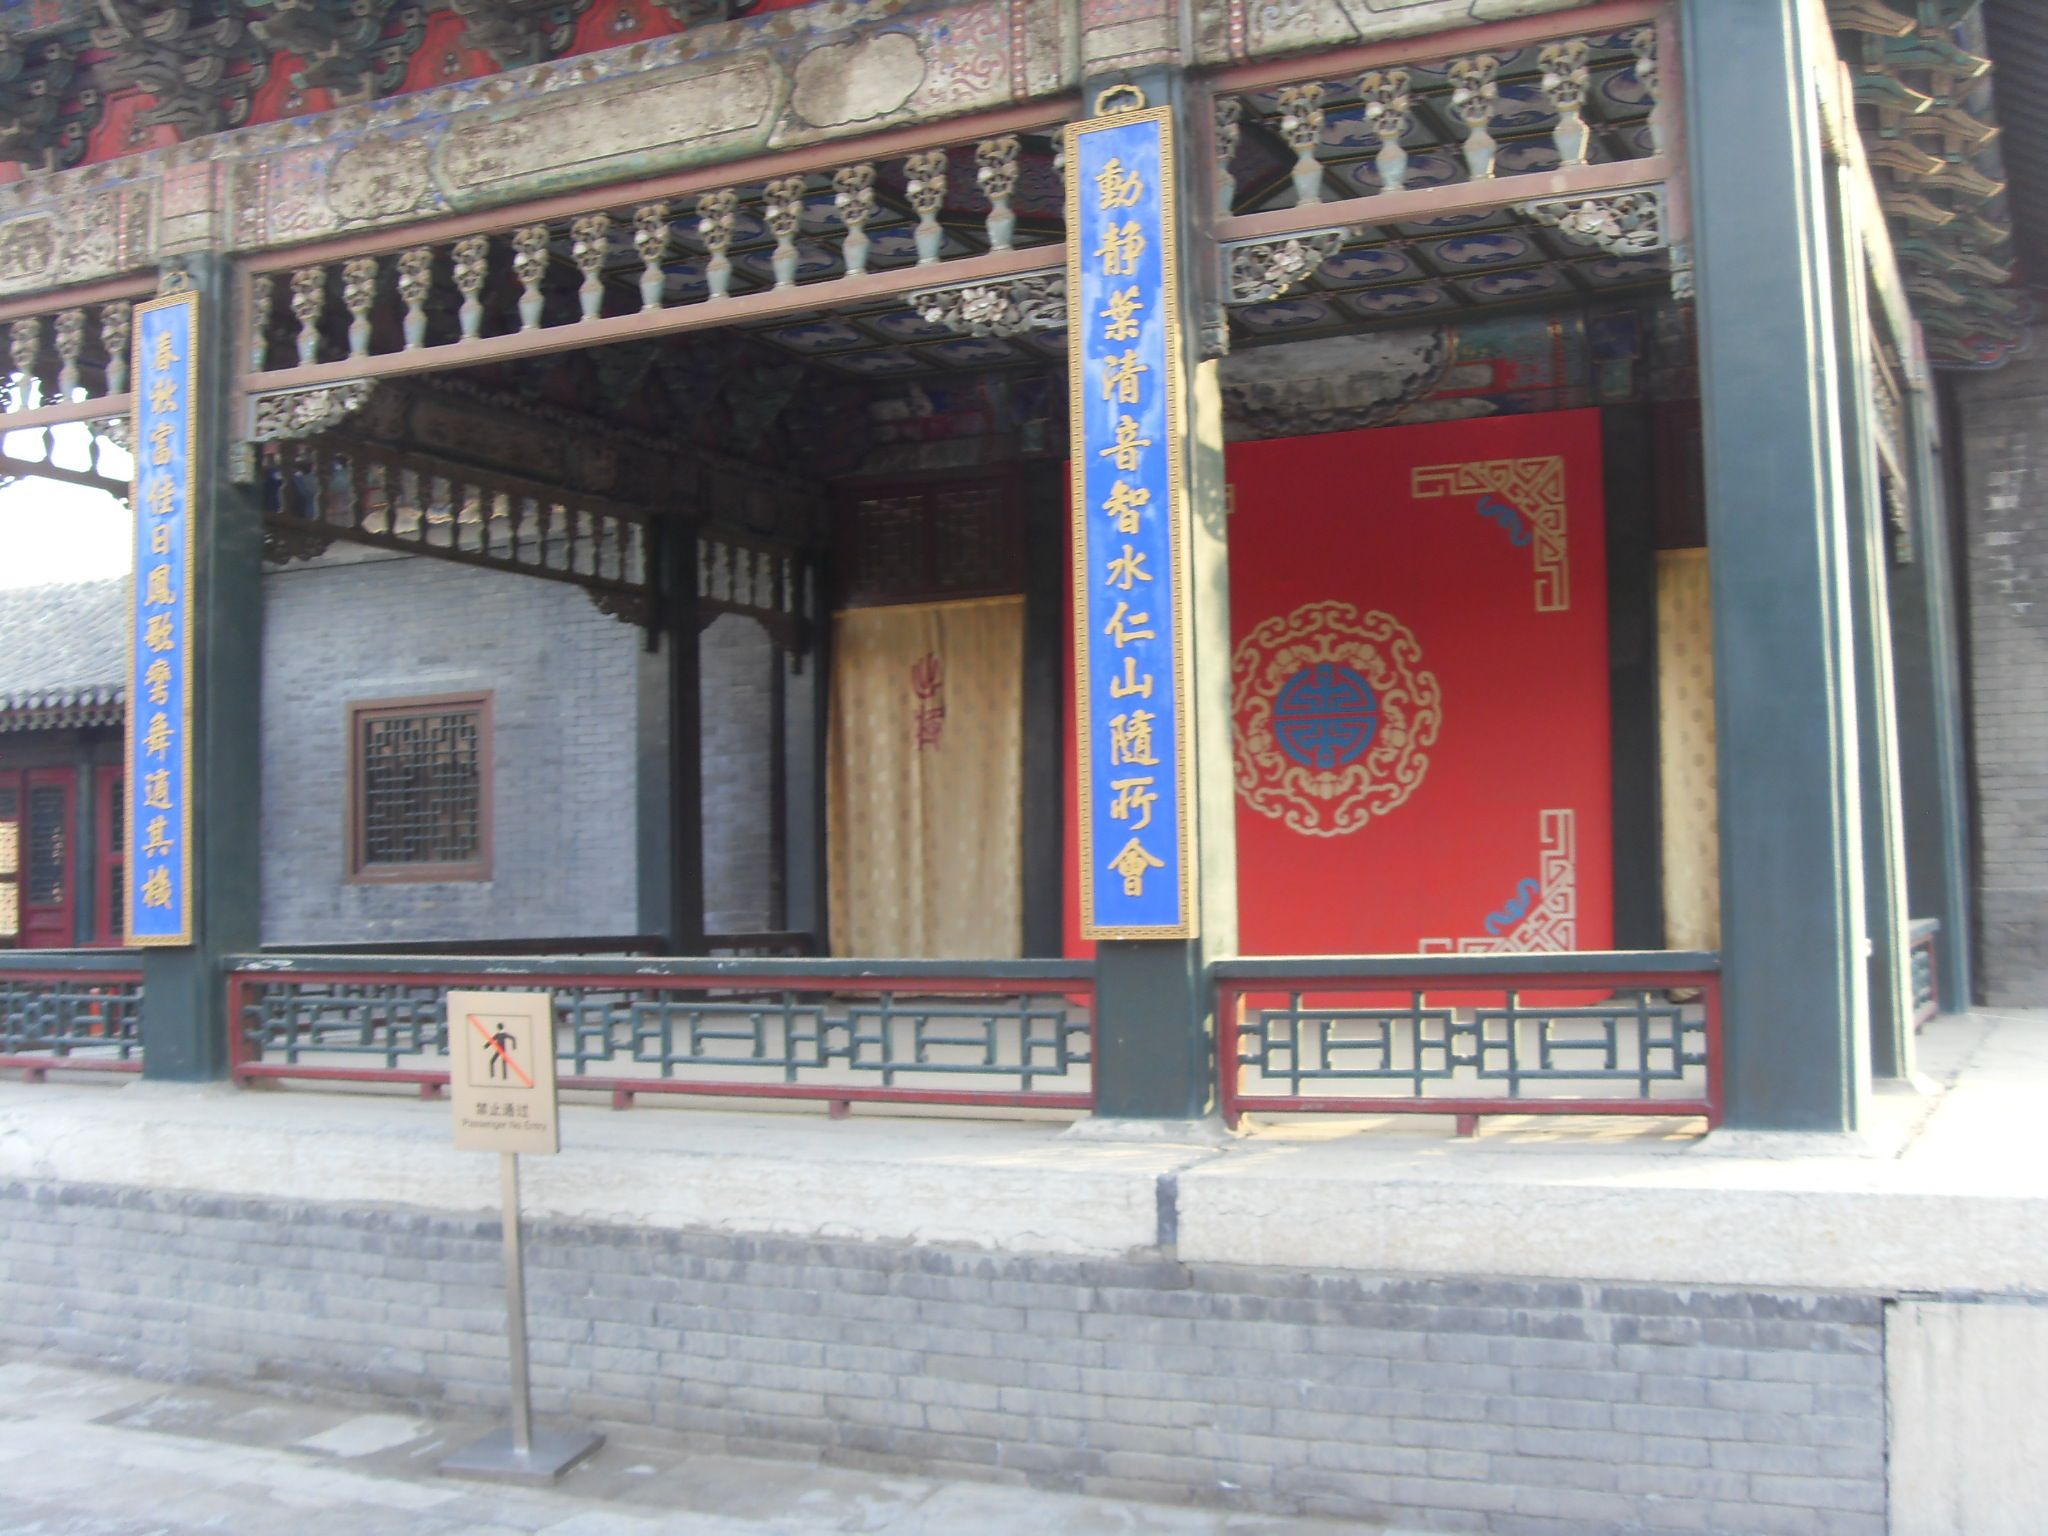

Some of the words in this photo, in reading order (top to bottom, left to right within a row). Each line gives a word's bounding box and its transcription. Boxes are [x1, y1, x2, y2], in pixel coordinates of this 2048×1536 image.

[476, 1102, 529, 1118] 禁止通过
[524, 1120, 547, 1132] Entry
